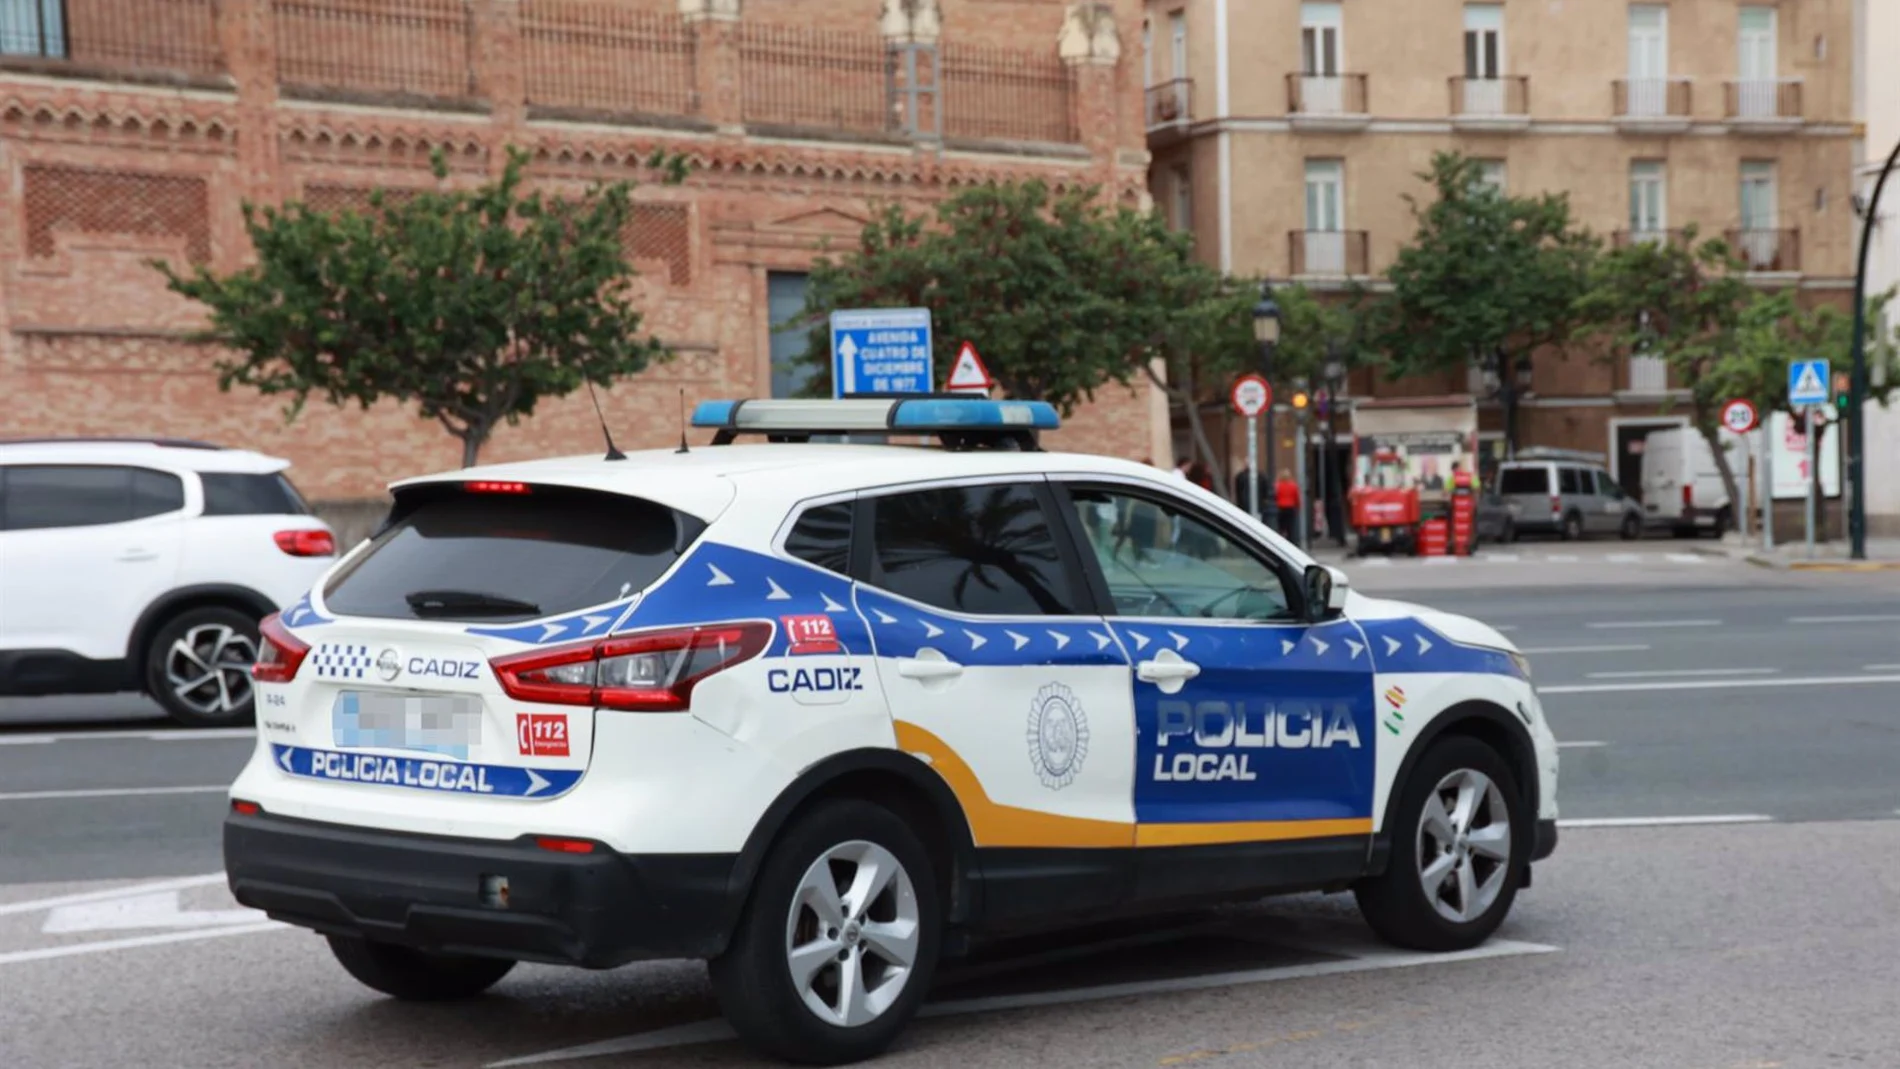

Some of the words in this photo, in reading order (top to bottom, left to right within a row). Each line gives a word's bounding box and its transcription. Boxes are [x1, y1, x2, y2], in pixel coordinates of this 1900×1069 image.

[867, 331, 918, 344] AVENIDA
[860, 346, 909, 360] CUATRO
[911, 345, 925, 359] DE
[863, 362, 924, 375] DICIEMBRE
[872, 377, 889, 391] DE
[892, 376, 917, 391] 1977
[801, 619, 831, 634] 112
[408, 657, 480, 679] CADIZ
[768, 668, 863, 692] CADIZ
[533, 720, 565, 739] 112
[1156, 700, 1361, 748] POLICIA
[311, 754, 400, 783] POLICIA
[403, 762, 494, 793] LOCAL
[1153, 754, 1257, 781] LOCAL
